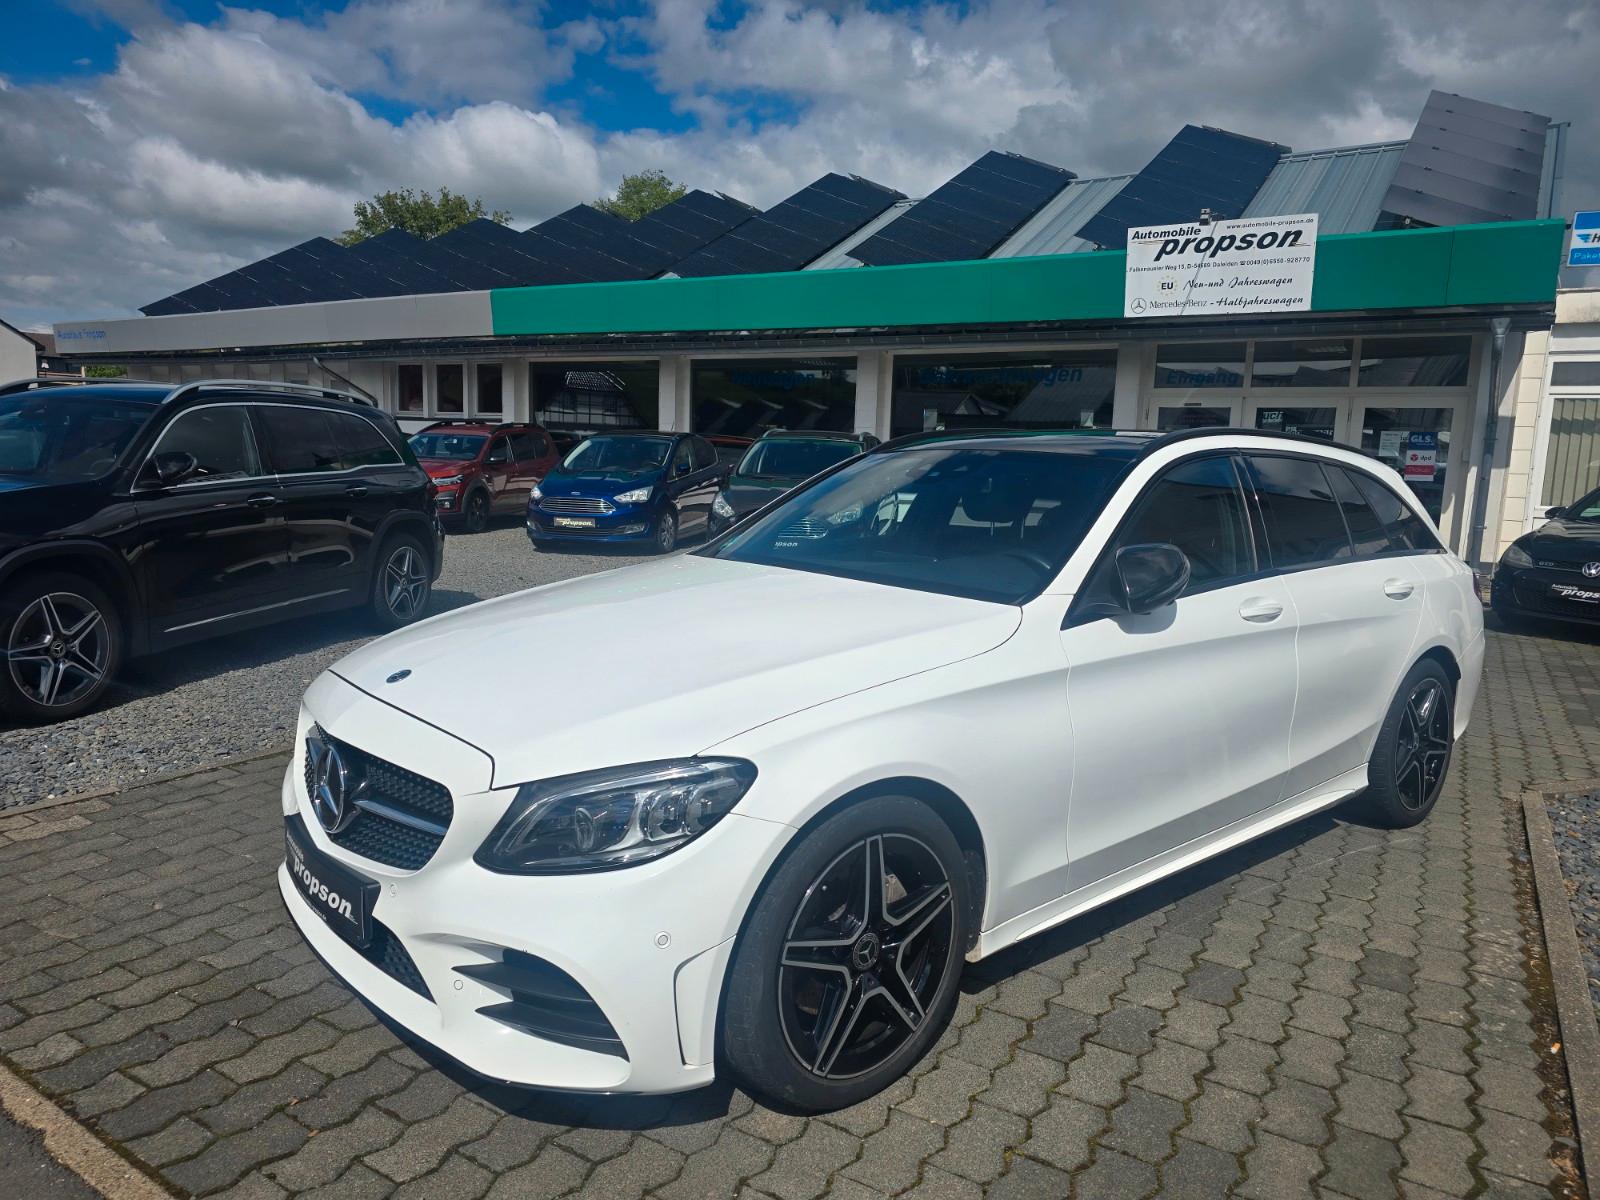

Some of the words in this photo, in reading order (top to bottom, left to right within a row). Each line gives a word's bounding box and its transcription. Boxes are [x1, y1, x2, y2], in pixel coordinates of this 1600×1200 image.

[1131, 226, 1202, 240] Automobile
[1153, 229, 1304, 262] propson
[1161, 282, 1174, 290] EU
[1228, 276, 1293, 289] Jahreswagen
[1149, 299, 1208, 309] Mercedes-Benz
[293, 855, 353, 919] propson
